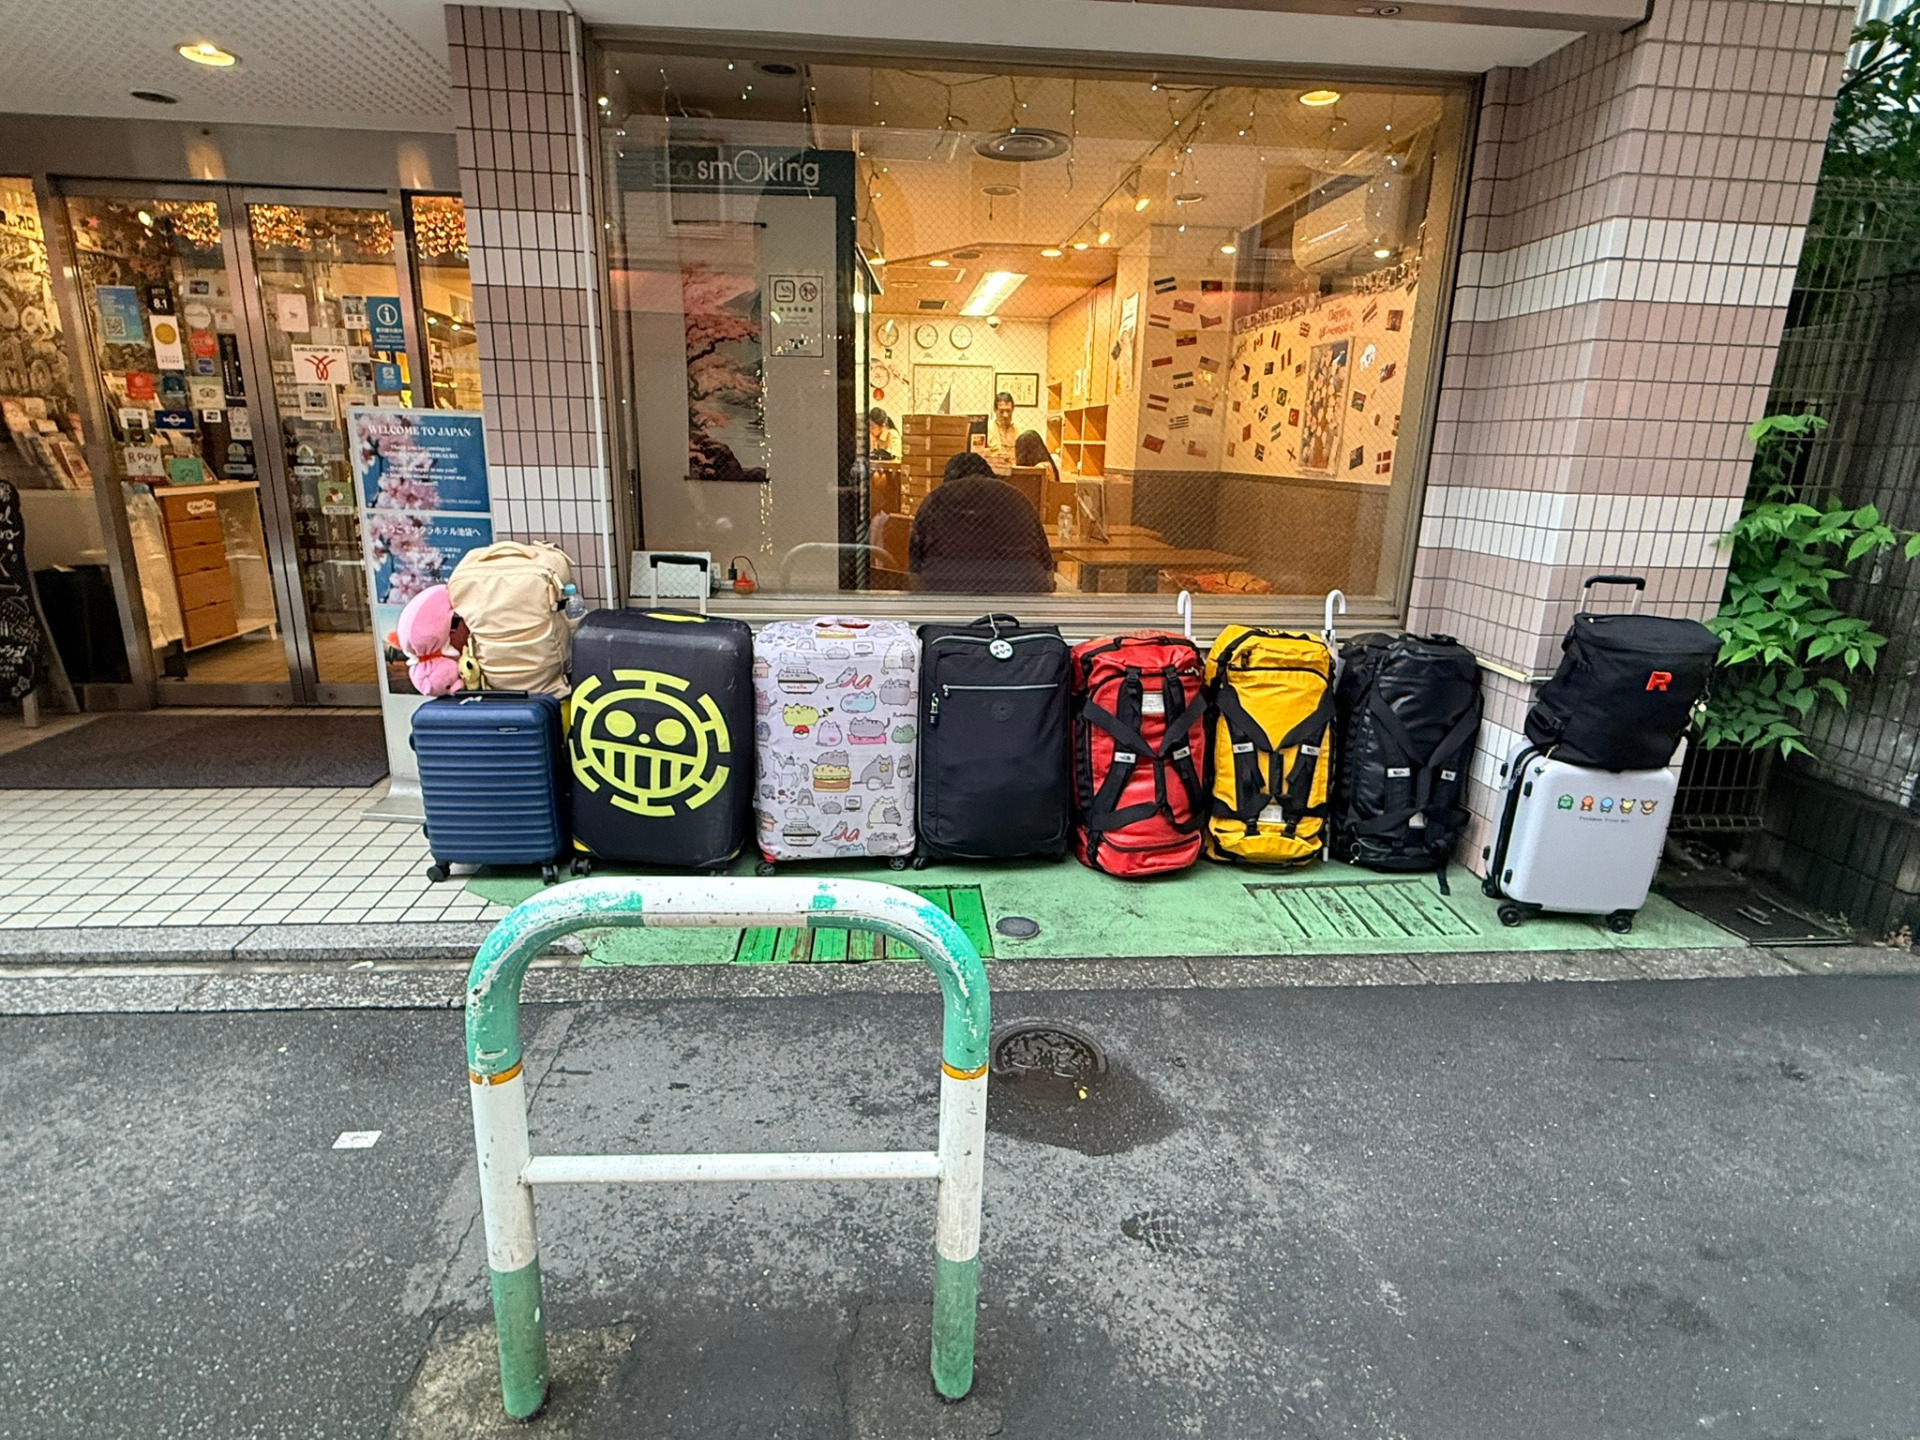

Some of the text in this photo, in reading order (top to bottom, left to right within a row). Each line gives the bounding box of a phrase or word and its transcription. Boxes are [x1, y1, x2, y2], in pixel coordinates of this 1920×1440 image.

[367, 425, 472, 438] WELCOME TO JAPAN
[381, 525, 481, 537] ようこそサクラホテル池袋へ
[1646, 671, 1673, 691] R
